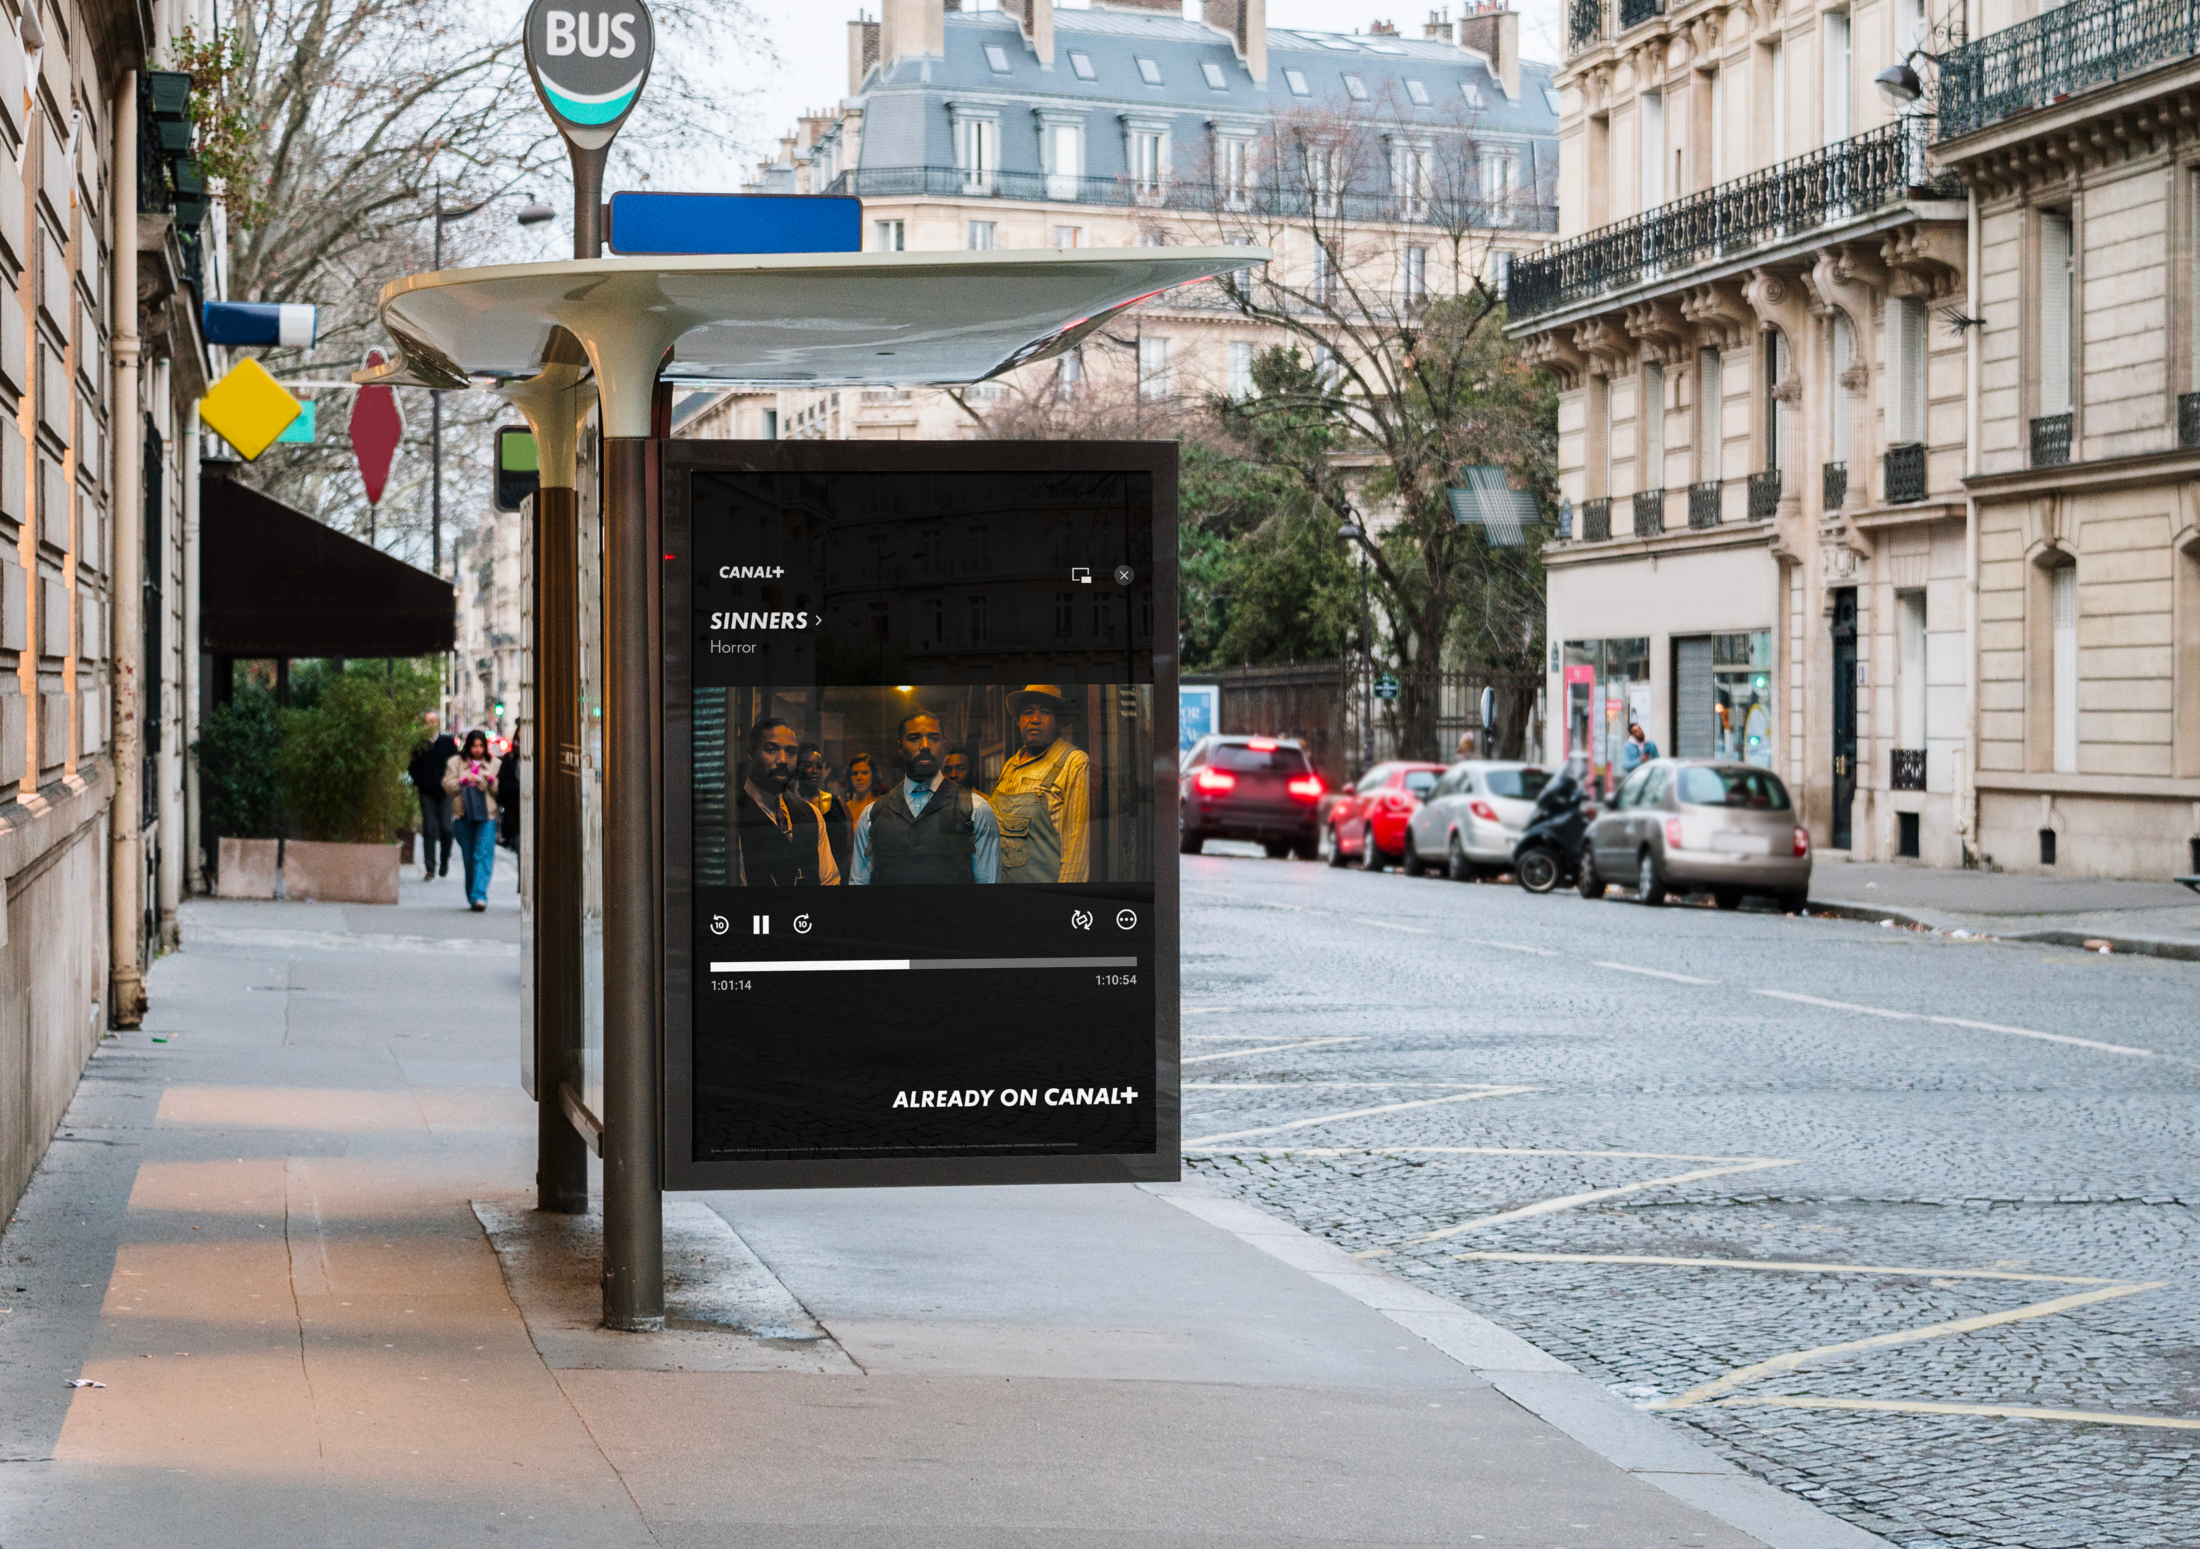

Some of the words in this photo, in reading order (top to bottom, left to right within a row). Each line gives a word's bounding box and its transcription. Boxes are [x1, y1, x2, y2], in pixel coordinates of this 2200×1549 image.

[547, 11, 636, 58] BUS
[720, 566, 785, 579] CANAL+
[710, 612, 808, 630] SINNERS
[711, 640, 757, 653] Horror
[711, 980, 752, 991] 1:01:14
[1095, 975, 1138, 986] 1:10:54
[892, 1090, 995, 1109] ALREADY
[999, 1088, 1038, 1107] ON
[1044, 1086, 1139, 1107] CANAL+
